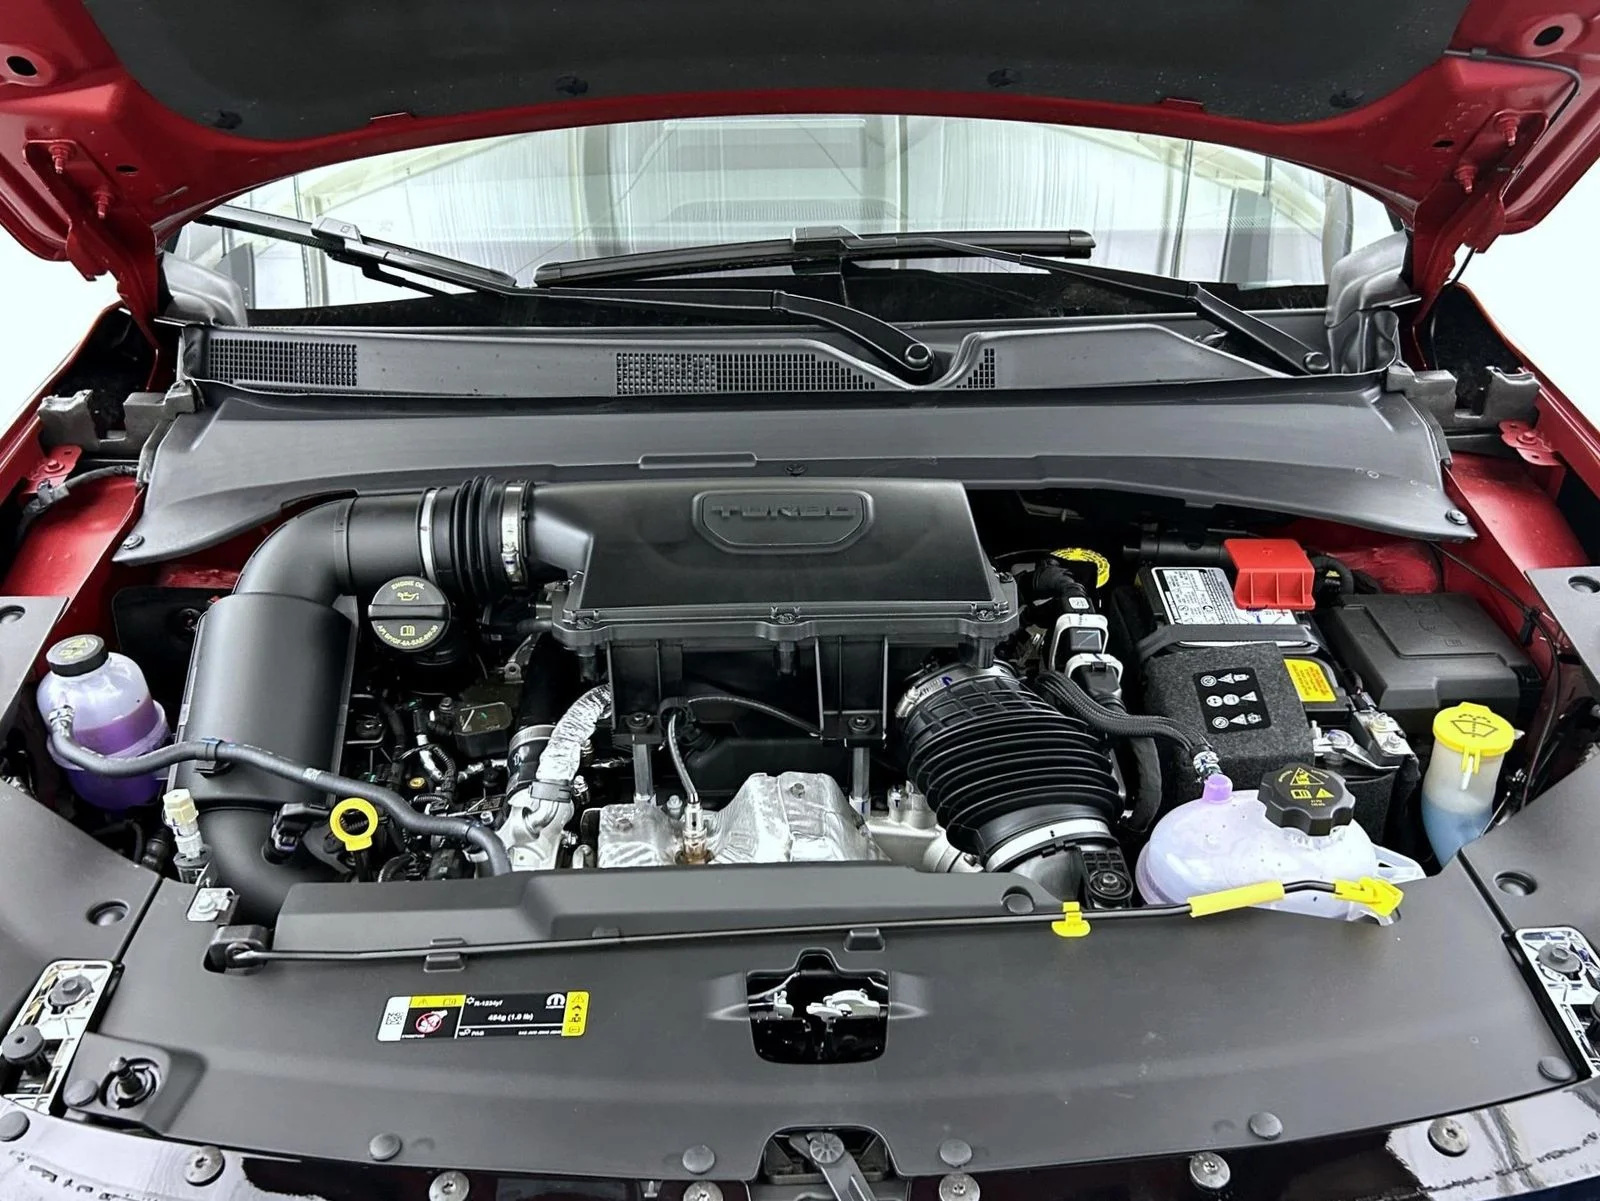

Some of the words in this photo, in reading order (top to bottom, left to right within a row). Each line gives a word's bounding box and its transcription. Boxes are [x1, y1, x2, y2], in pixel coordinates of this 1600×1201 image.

[391, 580, 414, 590] ENGINE
[415, 581, 425, 590] OIL
[474, 999, 503, 1007] R-1234yf
[523, 1013, 533, 1021] lb)
